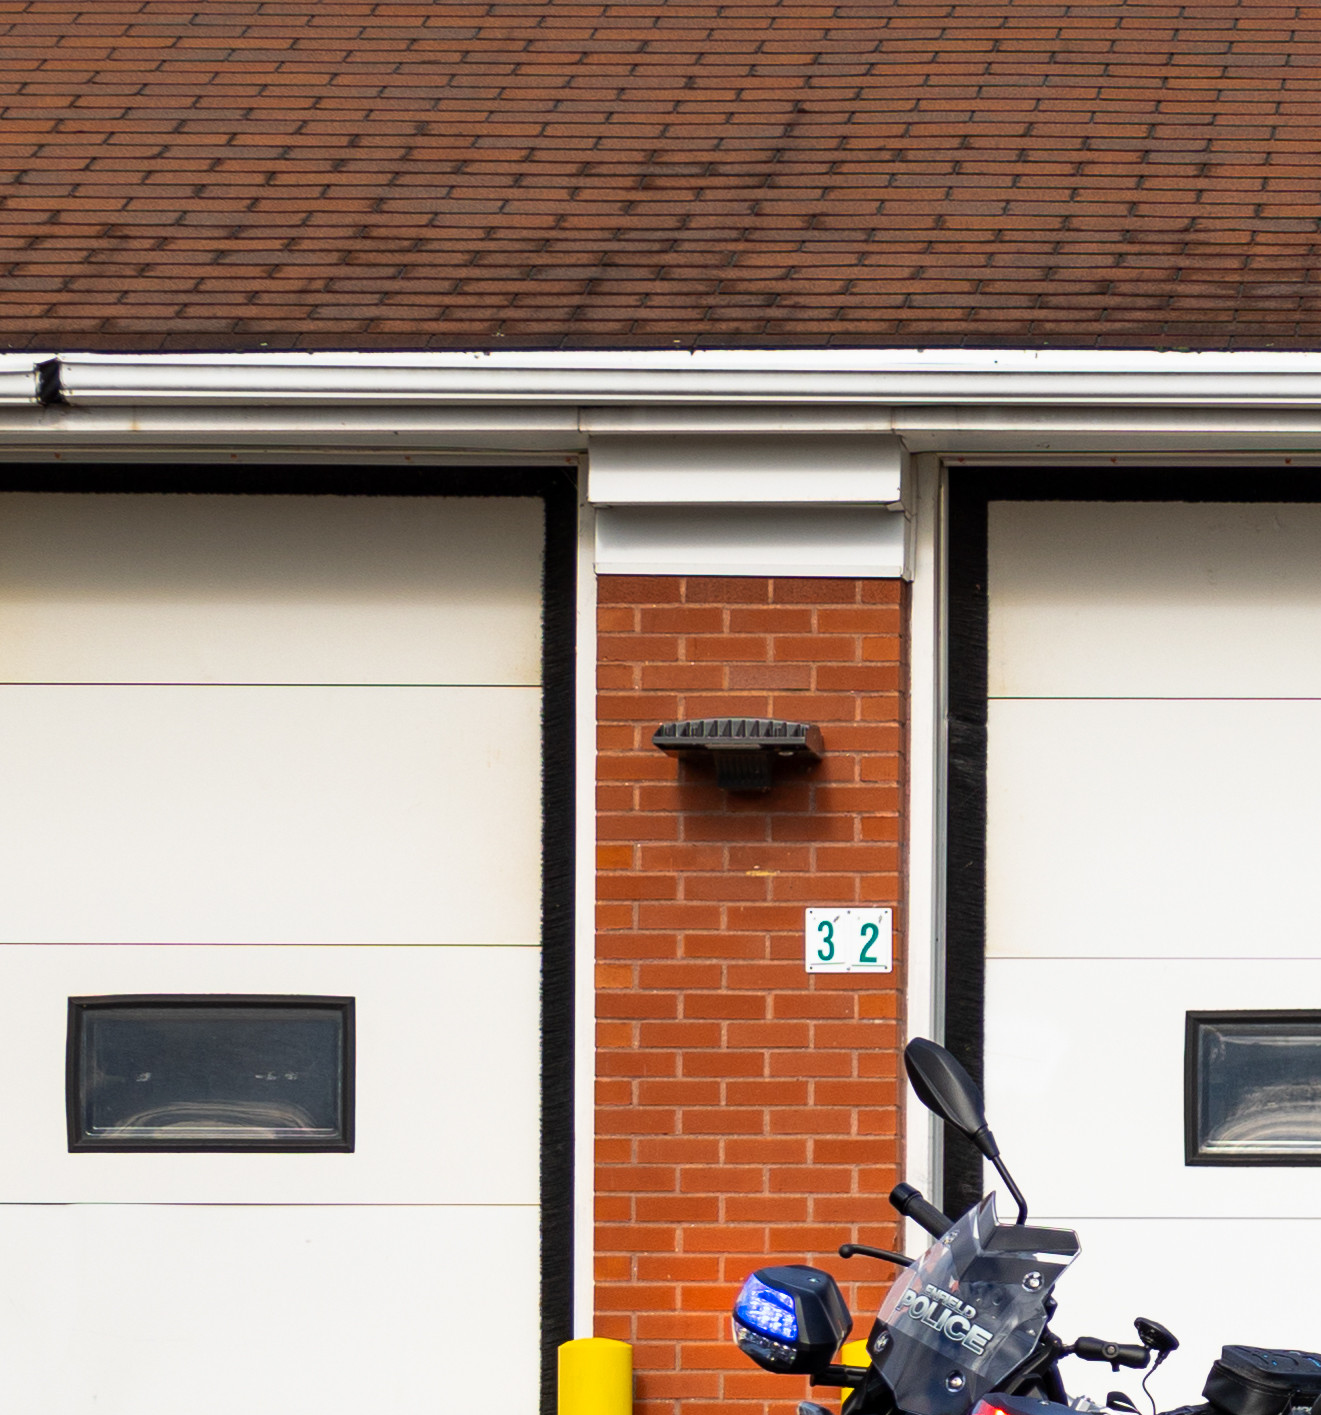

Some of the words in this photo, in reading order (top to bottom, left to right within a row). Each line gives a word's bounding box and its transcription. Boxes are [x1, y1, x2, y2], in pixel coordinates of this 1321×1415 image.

[818, 920, 879, 963] 32
[896, 1289, 993, 1356] POLICE
[924, 1284, 977, 1319] ENFIELD
